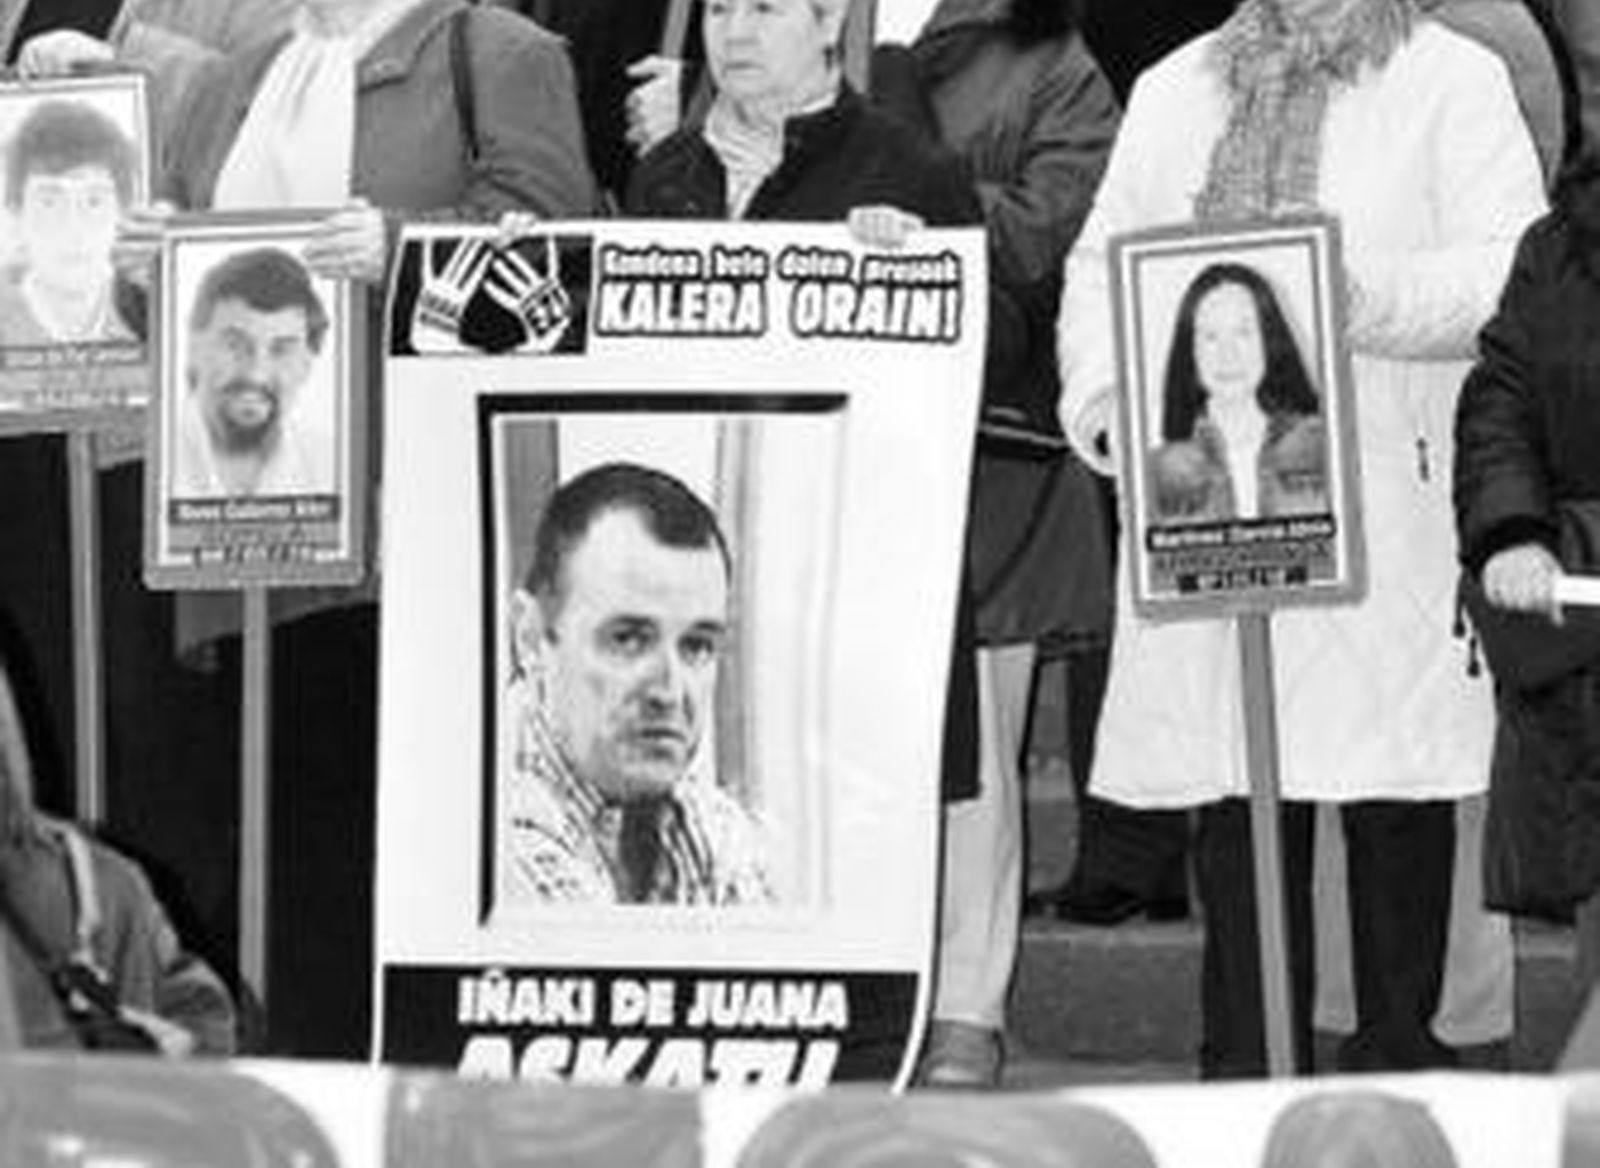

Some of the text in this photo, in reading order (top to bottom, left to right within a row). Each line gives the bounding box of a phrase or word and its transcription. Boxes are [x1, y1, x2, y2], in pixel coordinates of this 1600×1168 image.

[599, 281, 763, 332] KALERA
[795, 282, 957, 340] ORAIN!
[458, 970, 849, 1029] IÑAKI DE JUANA
